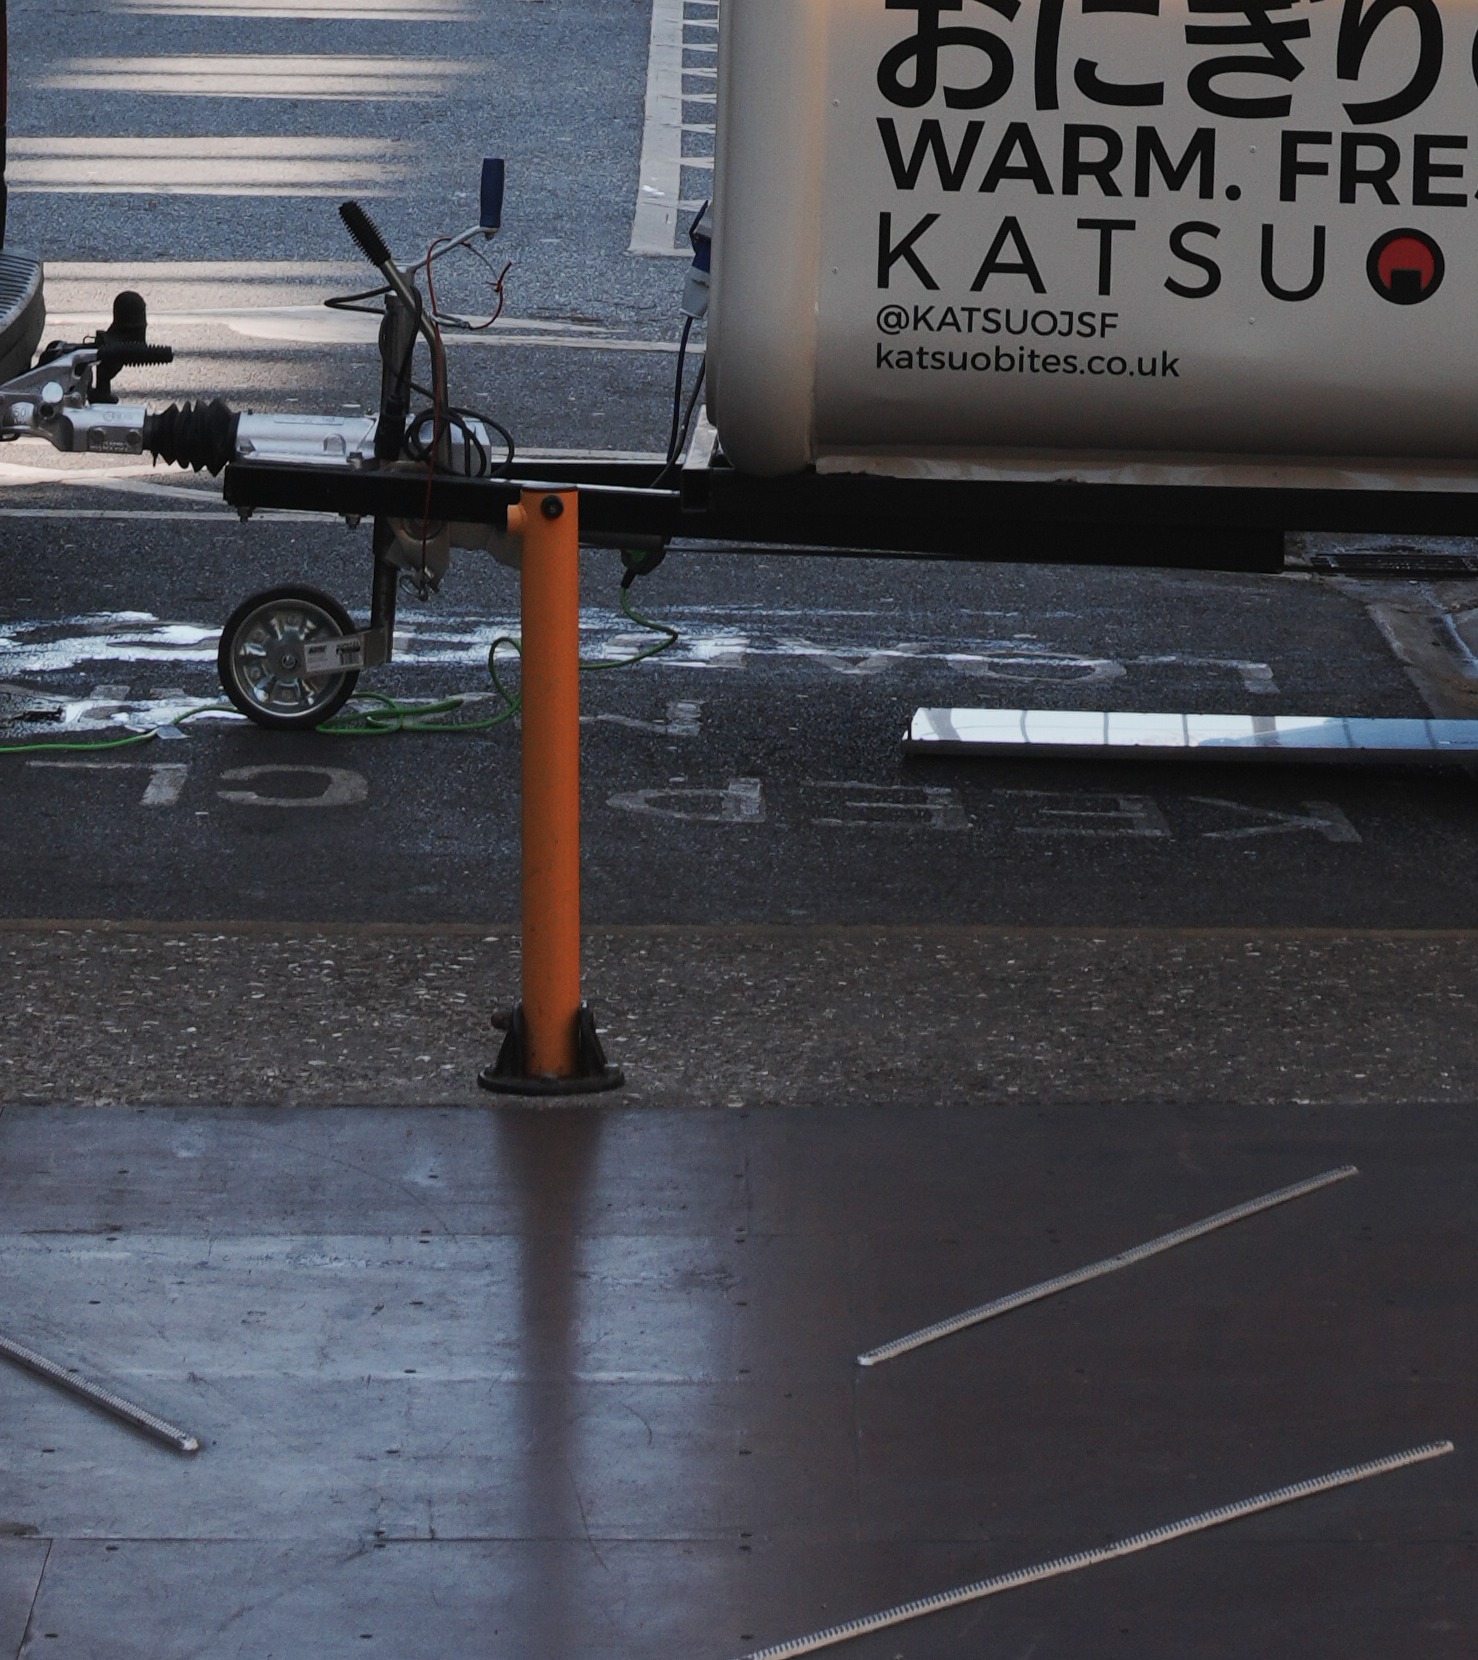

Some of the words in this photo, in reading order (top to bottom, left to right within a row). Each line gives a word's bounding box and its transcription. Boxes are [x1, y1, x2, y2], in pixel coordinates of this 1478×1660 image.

[876, 117, 1242, 202] WARM.
[876, 304, 1119, 340] @KATSUOJSF
[876, 343, 1181, 378] katsuobites.co.uk
[603, 777, 1365, 842] KEEP
